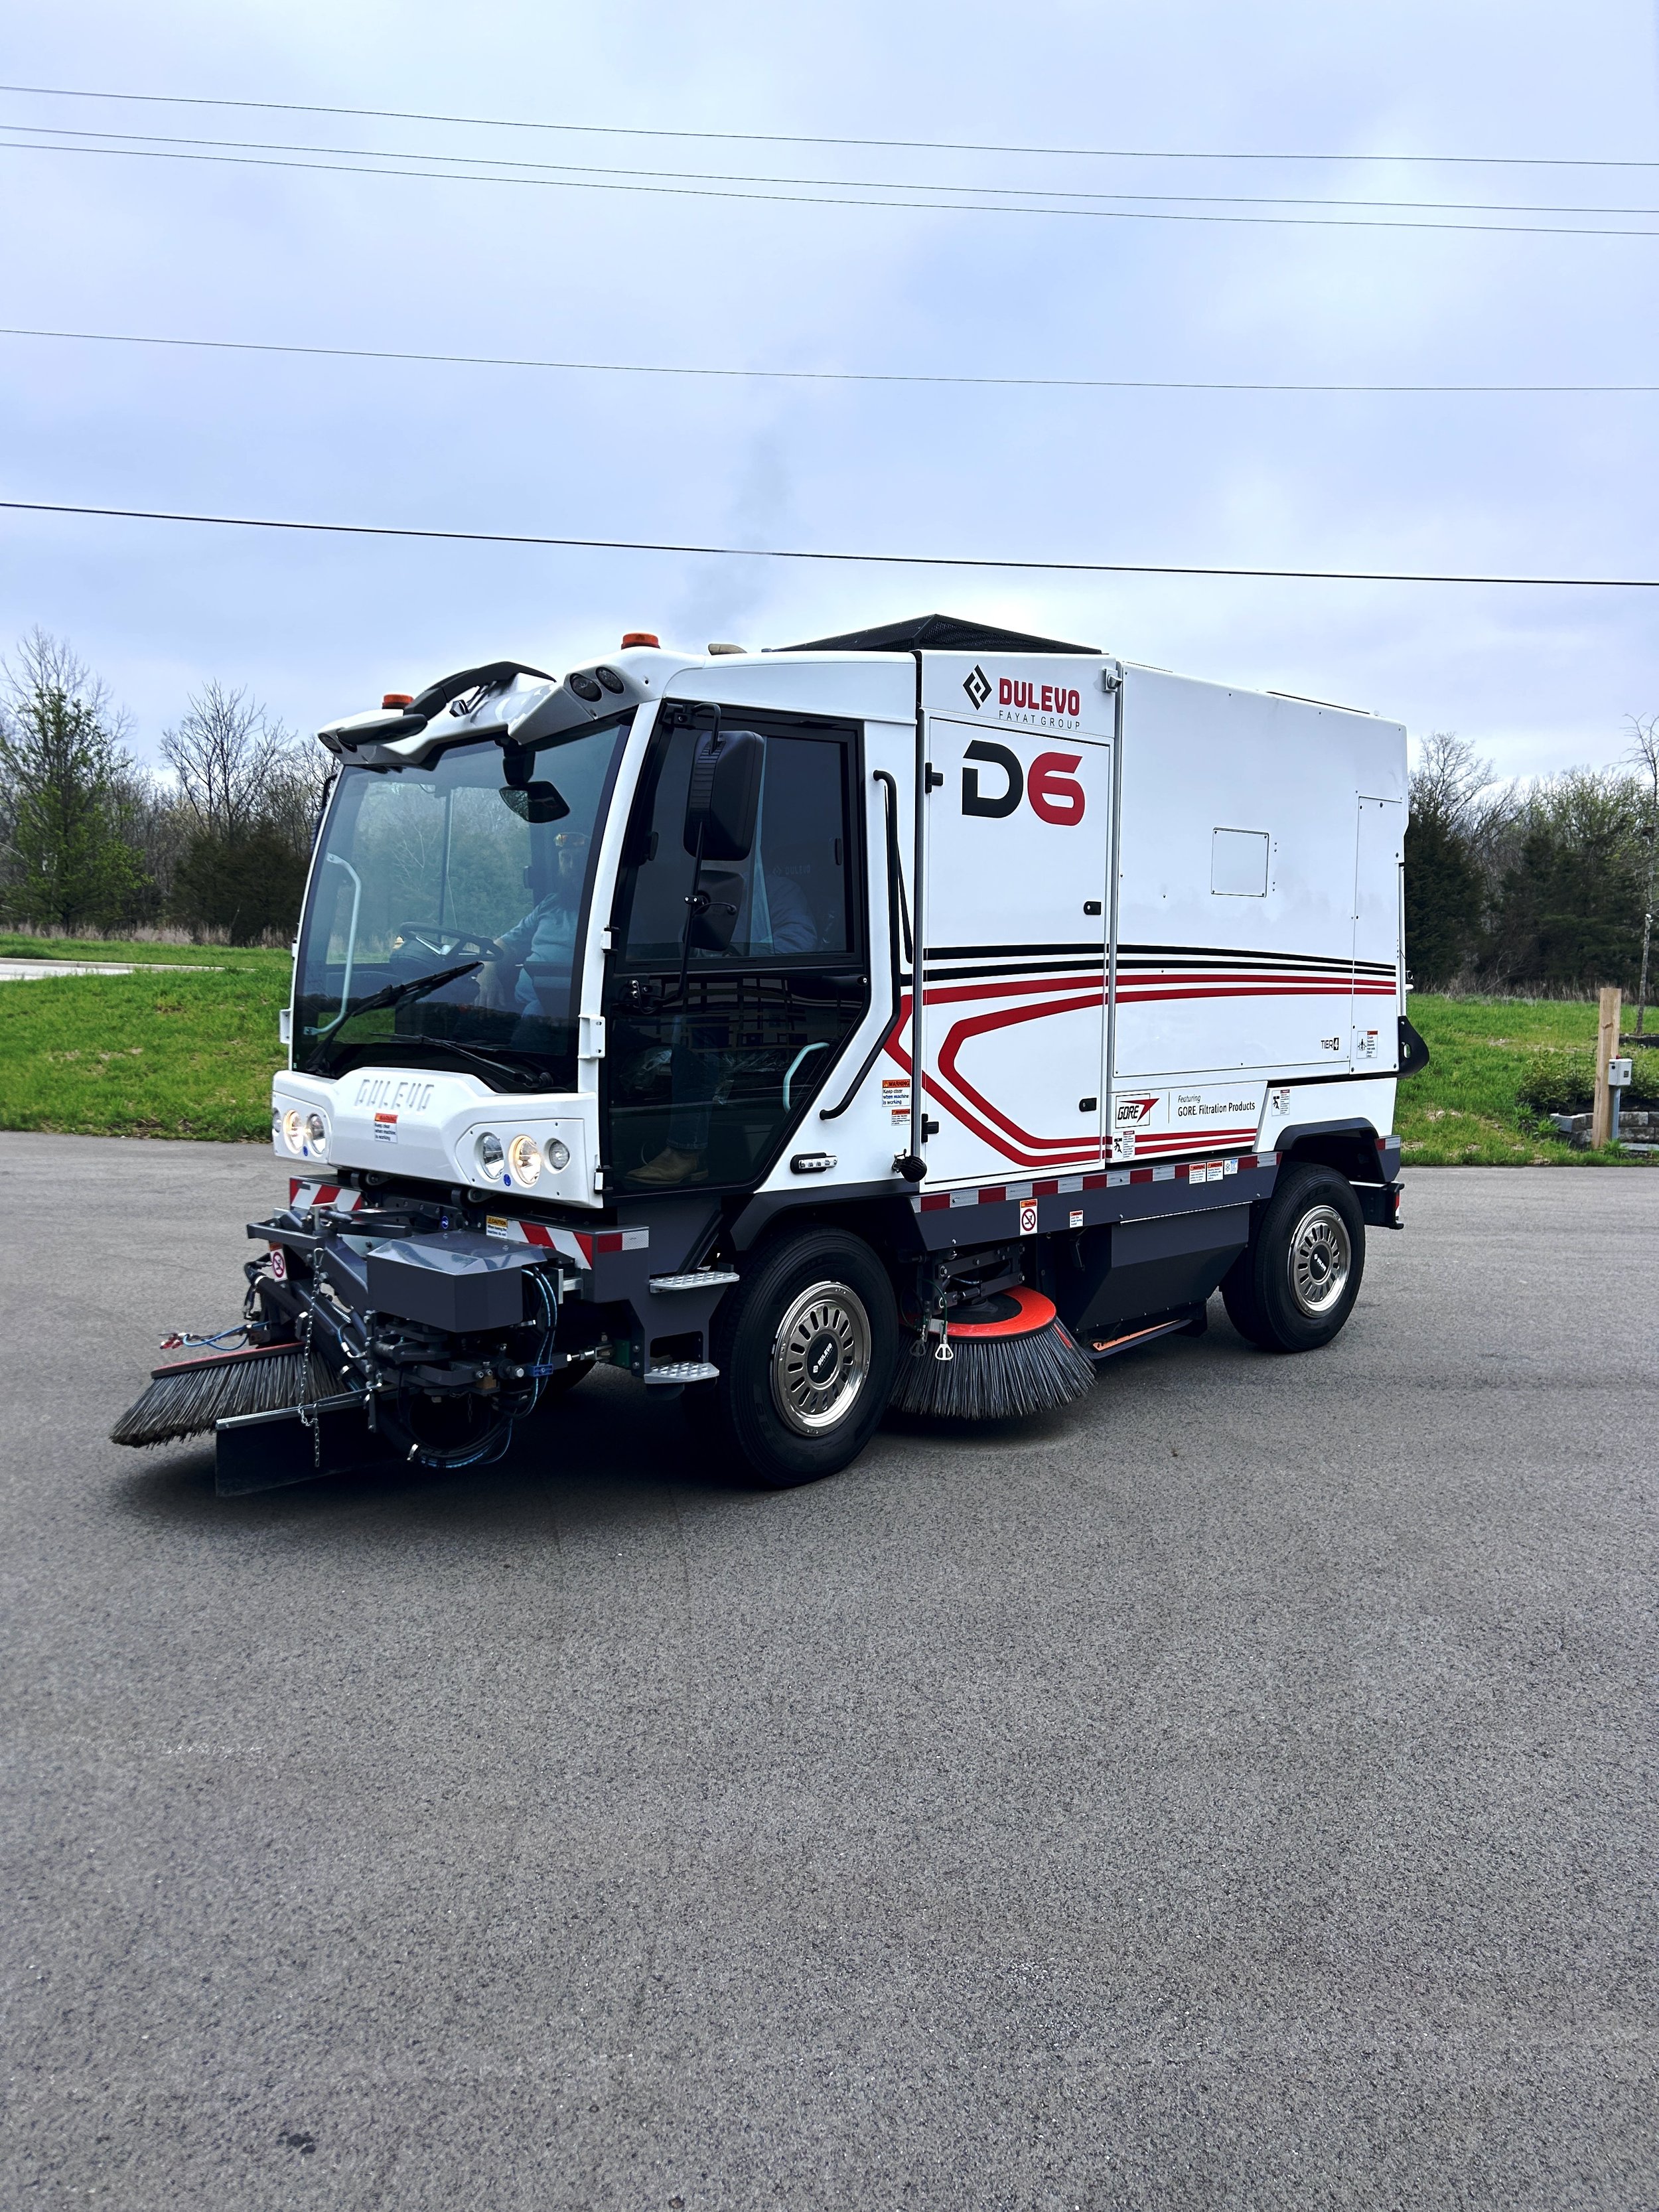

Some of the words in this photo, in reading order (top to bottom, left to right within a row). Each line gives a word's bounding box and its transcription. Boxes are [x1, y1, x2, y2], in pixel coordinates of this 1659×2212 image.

[999, 678, 1080, 717] DULEVO
[999, 710, 1036, 724] FAYAT
[1041, 716, 1080, 730] GROUP
[962, 739, 1086, 826] D6
[354, 1078, 435, 1113] DULEVO
[1178, 1094, 1201, 1103] Featuring
[1117, 1105, 1139, 1120] GORE
[1178, 1105, 1196, 1117] GORE
[1198, 1103, 1227, 1115] Filtration
[1228, 1101, 1256, 1112] Products
